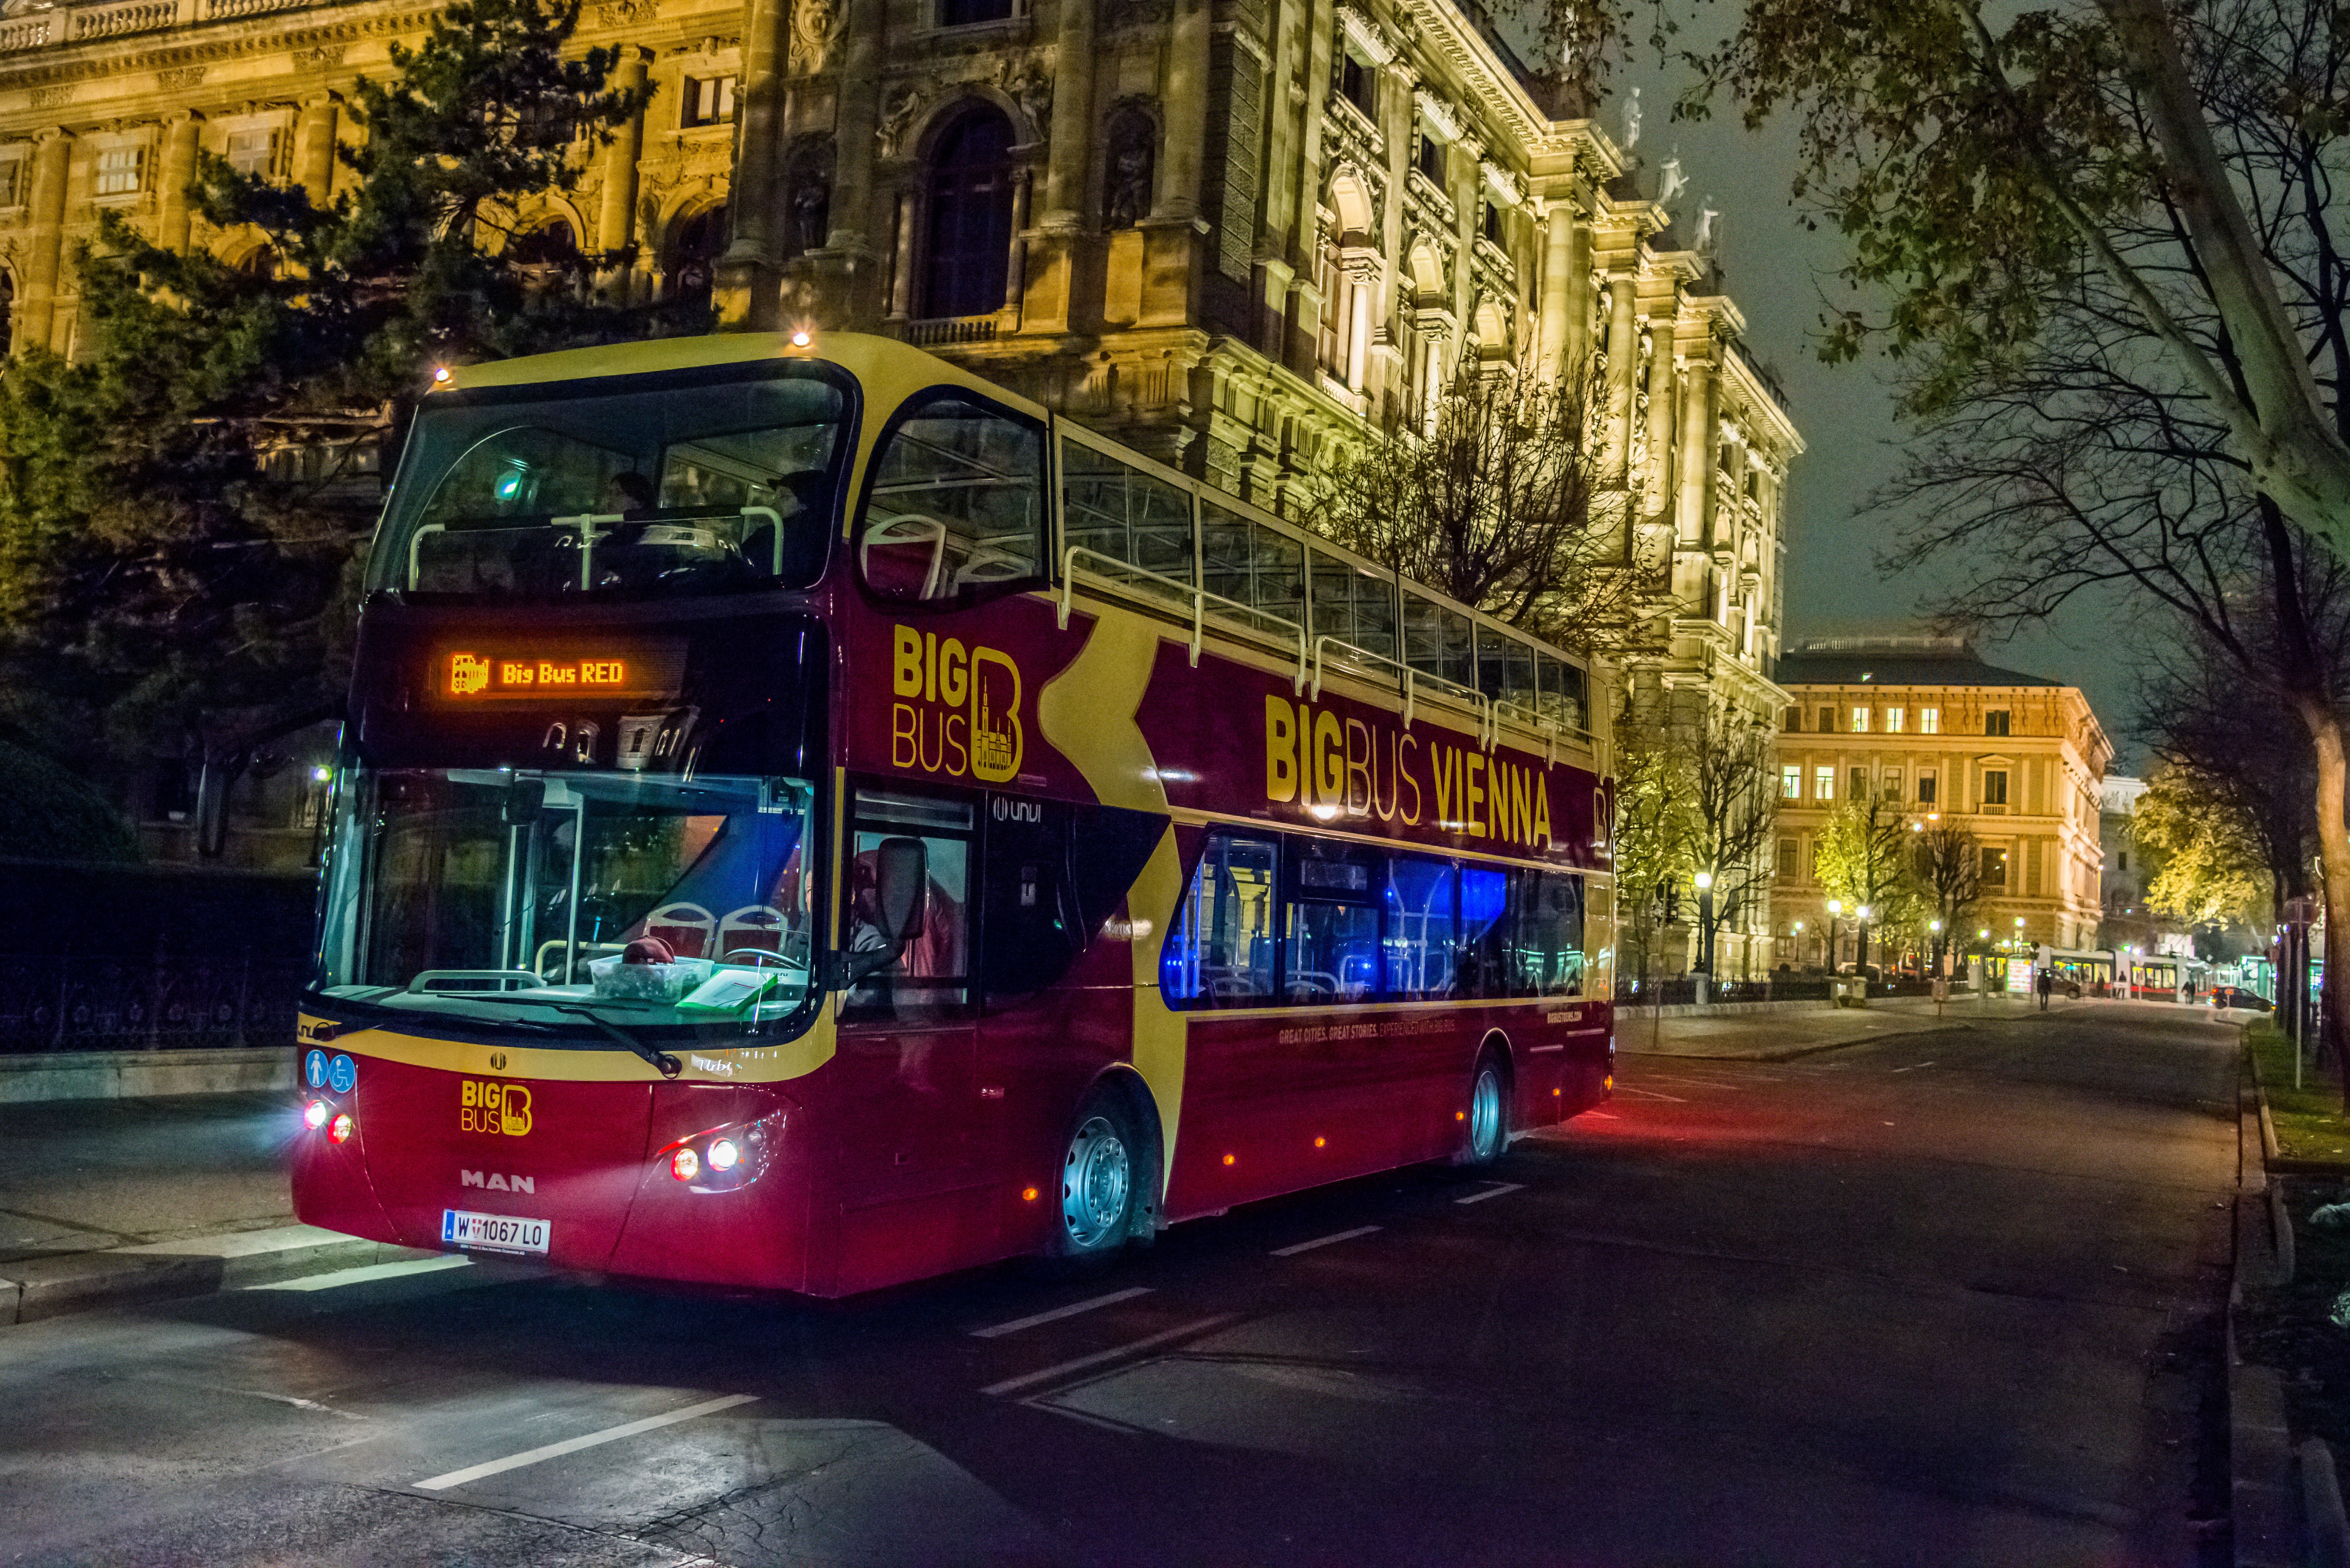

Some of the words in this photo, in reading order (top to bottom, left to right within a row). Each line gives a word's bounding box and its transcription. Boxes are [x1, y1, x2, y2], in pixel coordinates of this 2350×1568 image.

[503, 664, 533, 684] Big
[540, 663, 576, 683] Bus
[581, 663, 623, 683] RED
[894, 624, 968, 707] BIG
[893, 702, 967, 776] BUS
[1431, 741, 1552, 850] VIENNA
[1279, 1028, 1302, 1045] GREAT
[1329, 1025, 1350, 1041] GREAT
[462, 1080, 501, 1109] BIG
[462, 1108, 500, 1134] BUS
[461, 1169, 535, 1194] MAN
[482, 1219, 519, 1243] 1067
